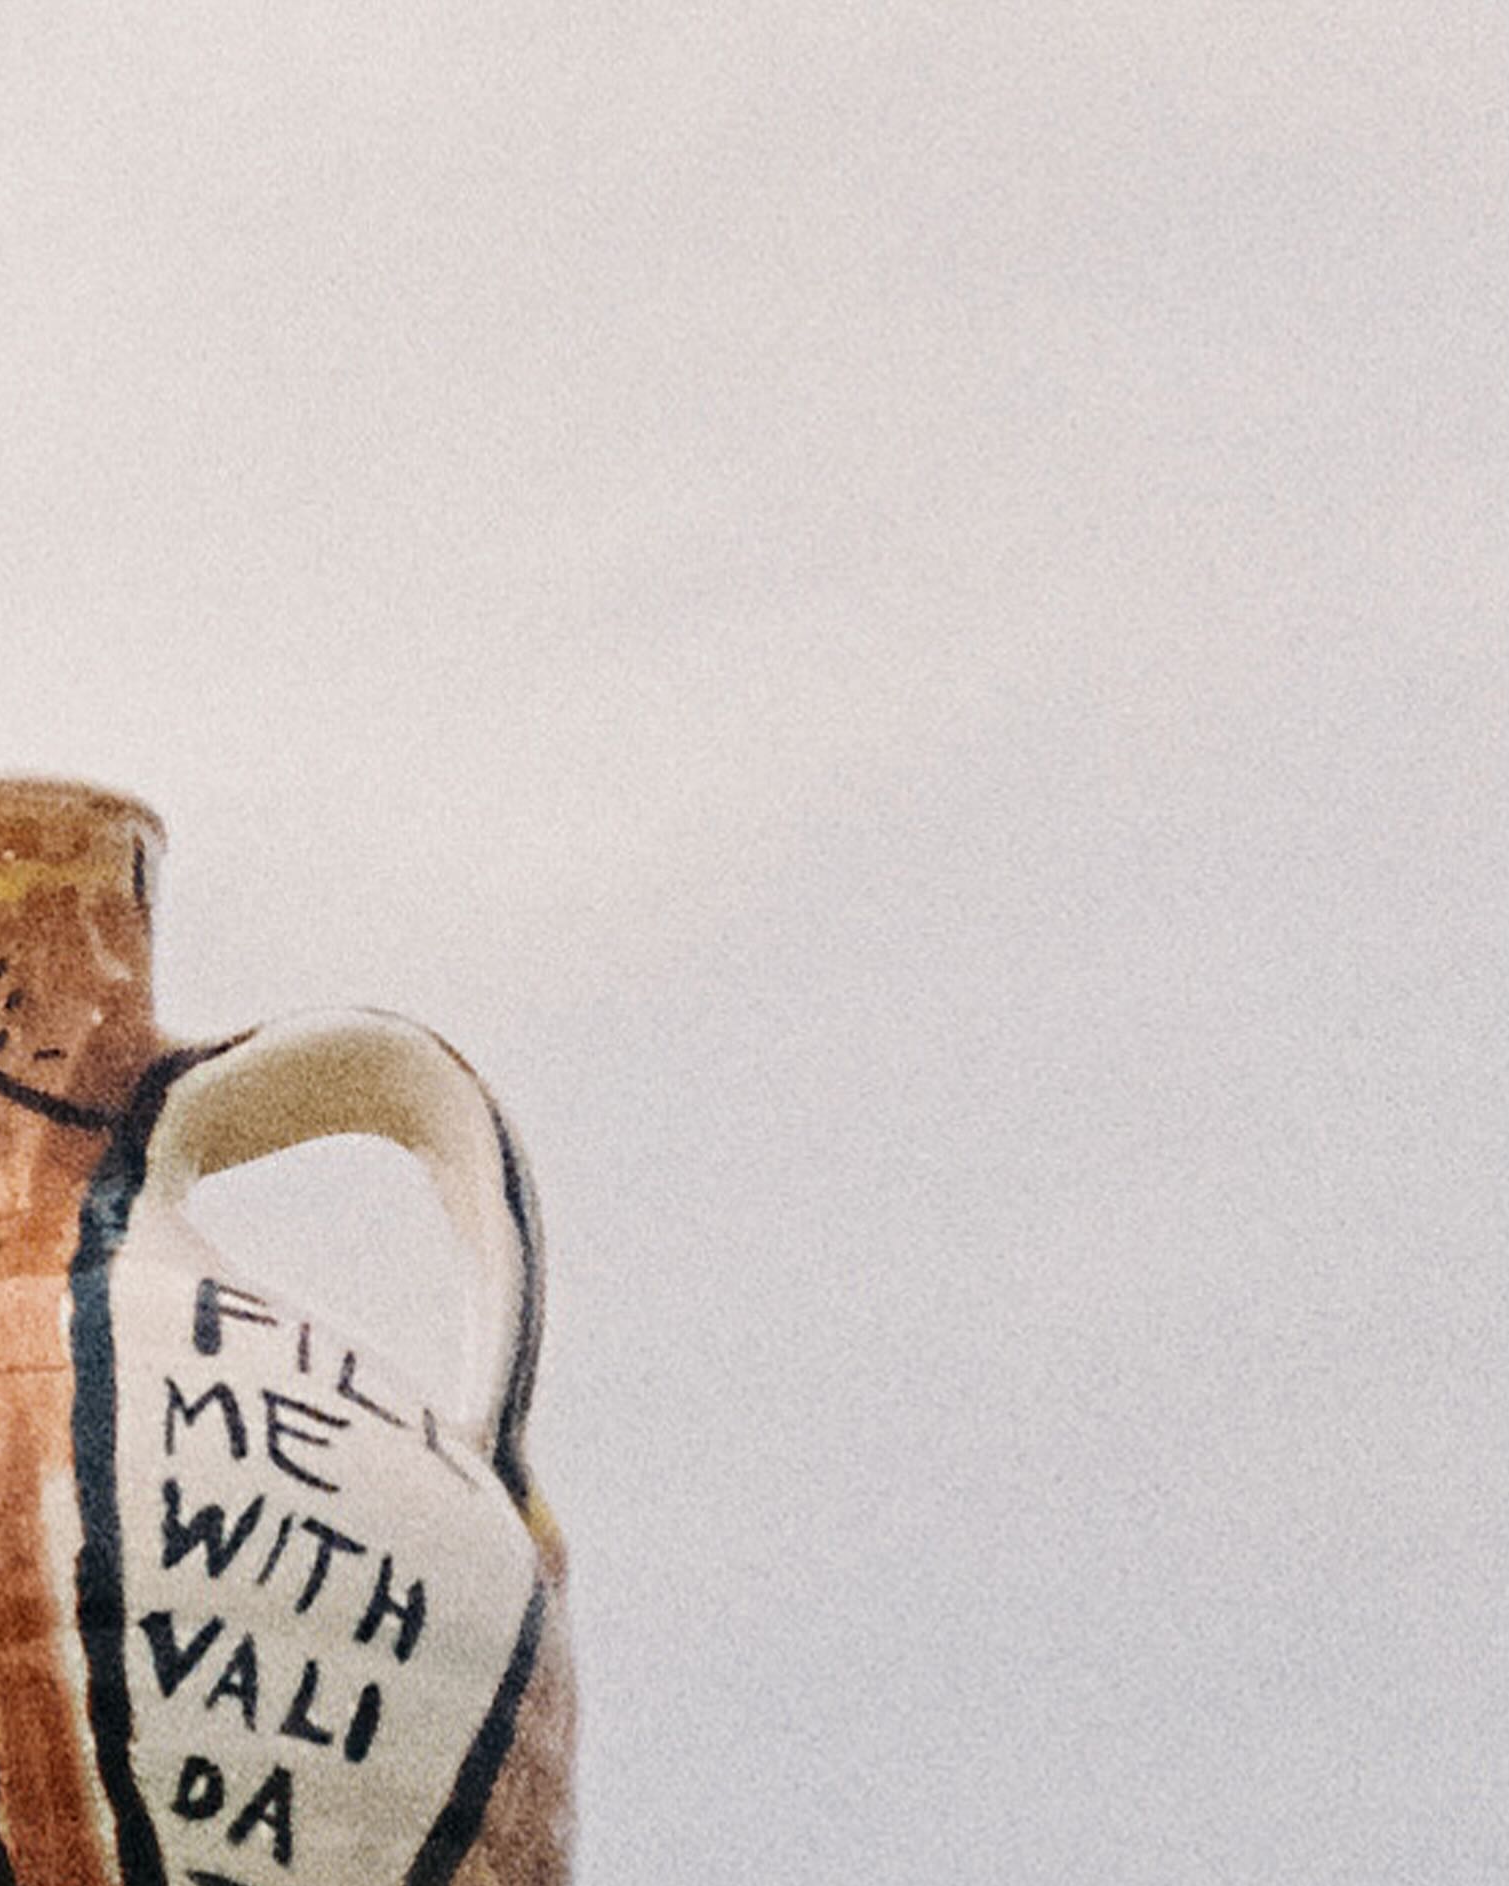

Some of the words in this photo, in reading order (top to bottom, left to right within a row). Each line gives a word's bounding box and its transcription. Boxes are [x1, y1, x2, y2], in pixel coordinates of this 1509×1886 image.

[165, 1376, 350, 1493] ME
[194, 1277, 480, 1490] FILL
[161, 1478, 427, 1664] WITH
[138, 1610, 381, 1762] VALI
[170, 1756, 293, 1866] DA
